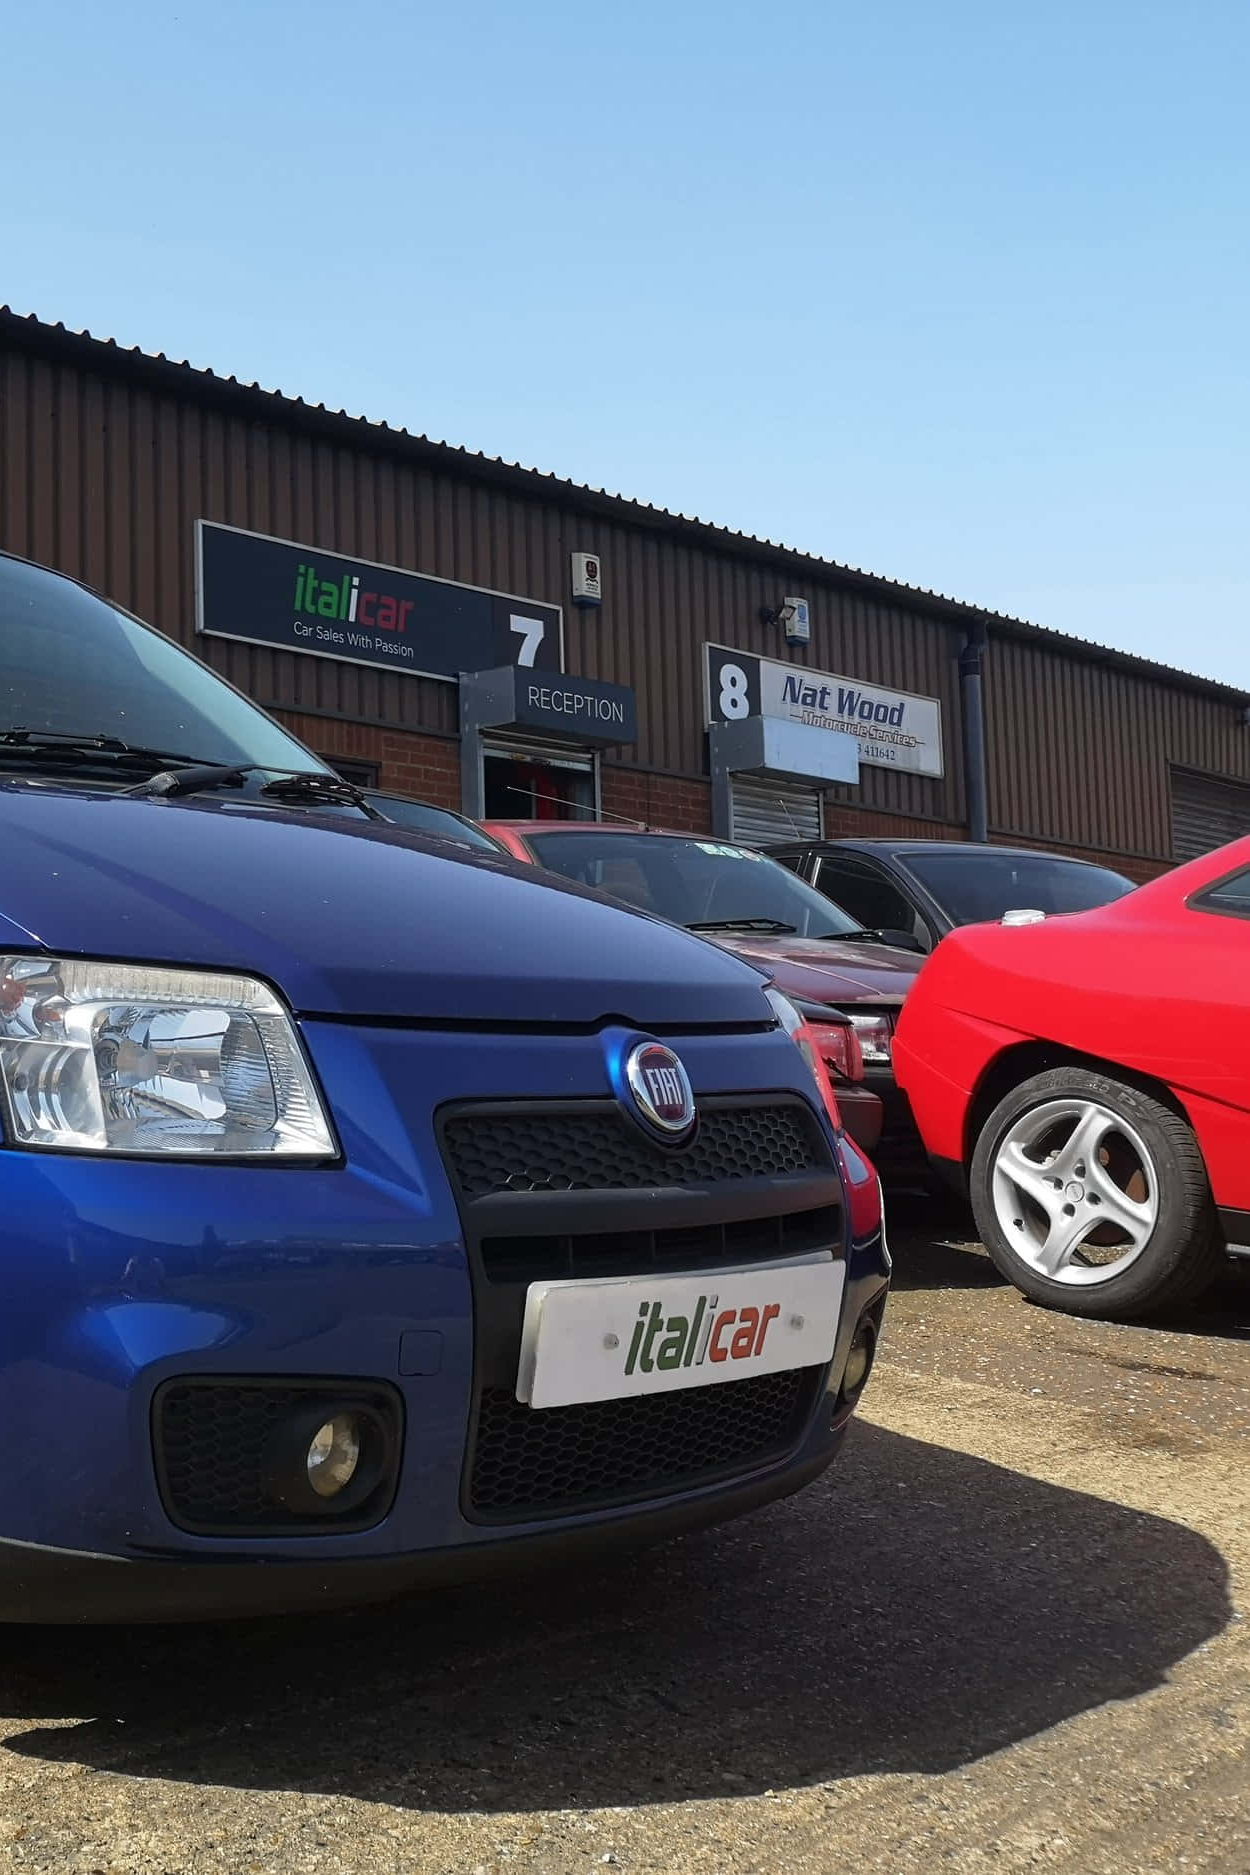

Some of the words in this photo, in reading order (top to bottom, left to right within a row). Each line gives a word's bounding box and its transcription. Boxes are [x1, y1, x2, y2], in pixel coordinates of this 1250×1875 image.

[294, 564, 415, 633] italicar
[293, 621, 314, 637] Car
[316, 626, 344, 644] Sales
[347, 631, 373, 650] With
[375, 638, 415, 659] Passion
[509, 613, 545, 668] 7
[528, 686, 623, 723] RECEPTION
[718, 663, 750, 721] 8
[782, 675, 832, 711] Nat
[837, 687, 906, 728] Wood
[801, 710, 869, 738] Motorcycle
[869, 725, 917, 748] Services
[644, 1066, 685, 1107] FIAT
[623, 1293, 781, 1377] italicar
